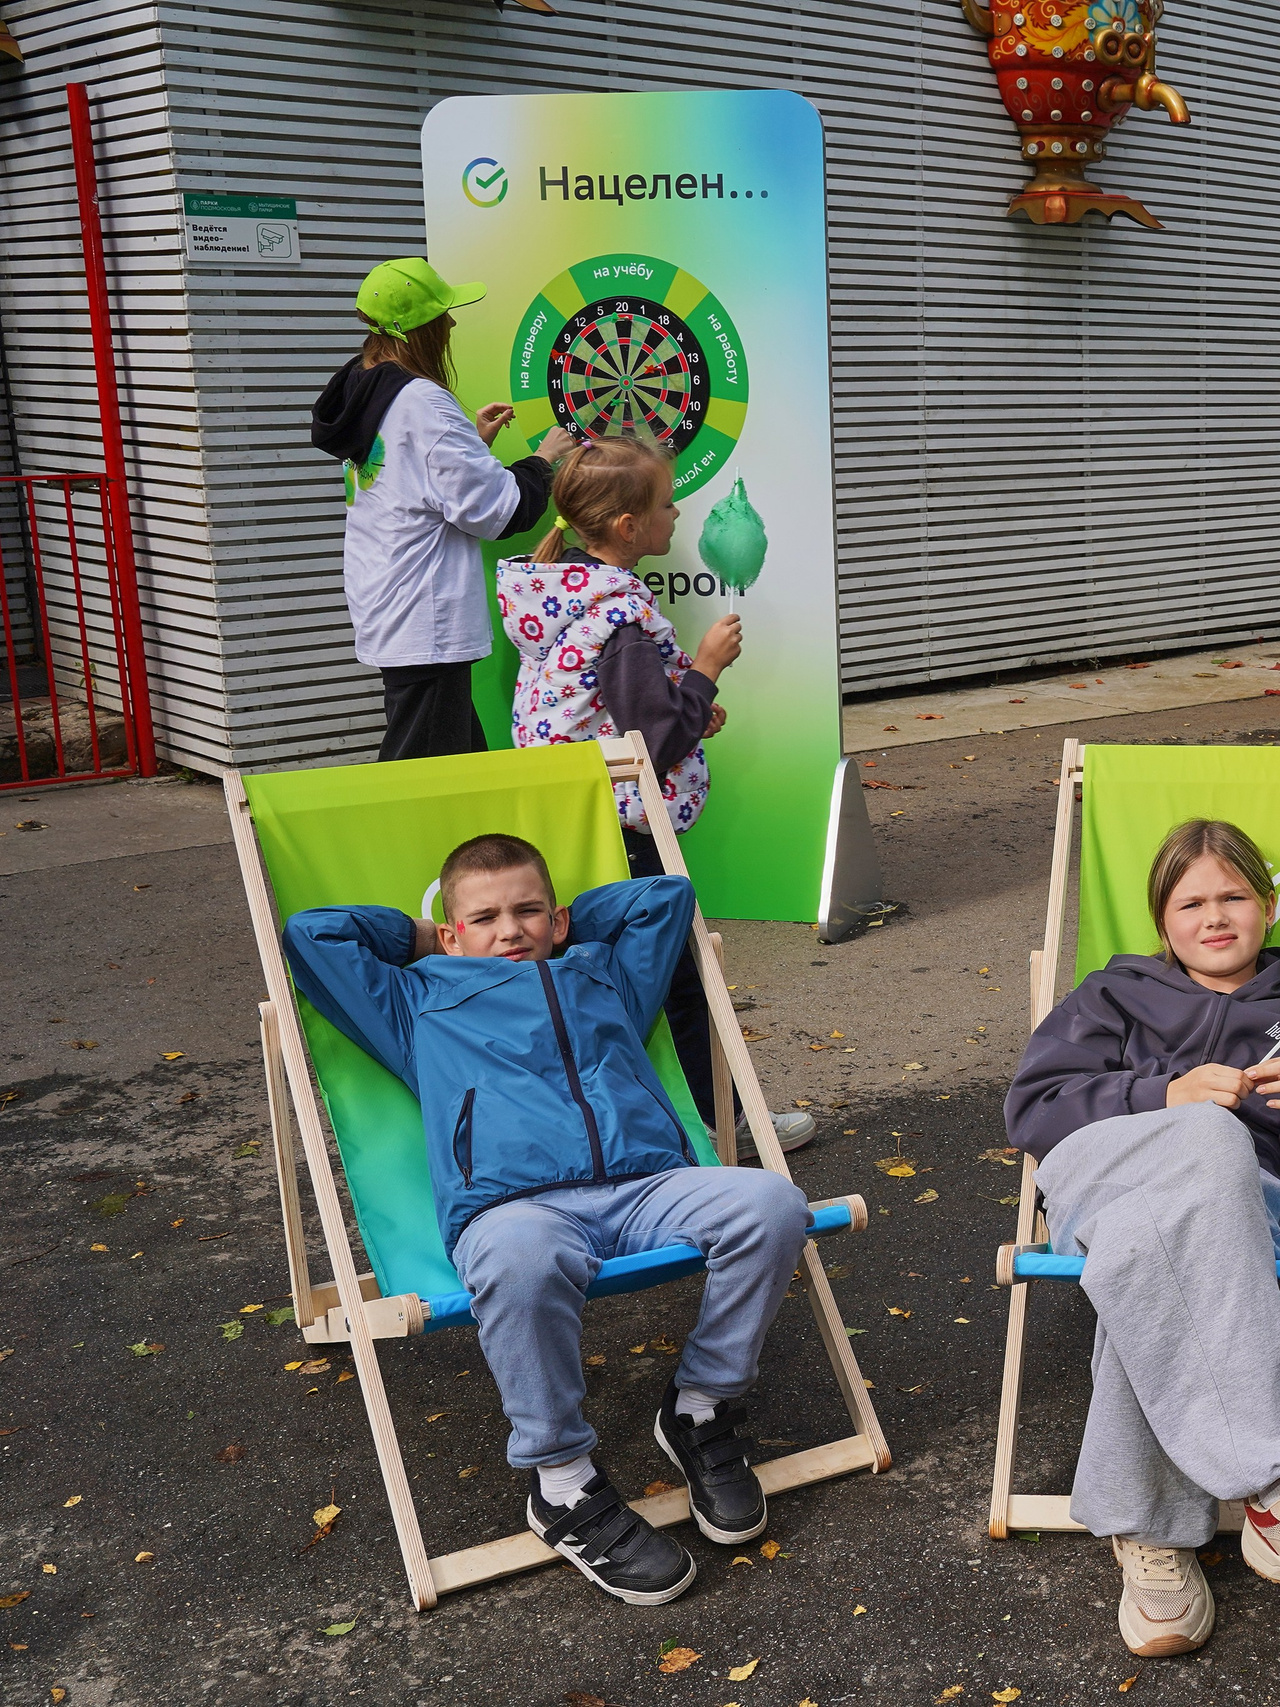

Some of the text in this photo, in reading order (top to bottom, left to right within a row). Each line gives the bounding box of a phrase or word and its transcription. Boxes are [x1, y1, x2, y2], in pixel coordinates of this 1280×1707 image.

[538, 166, 769, 206] Нацелен...
[192, 224, 228, 233] Ведётся
[194, 244, 250, 253] наблюдение!
[593, 263, 654, 280] на учёбу
[597, 306, 604, 315] 5
[615, 302, 629, 312] 20
[640, 305, 646, 314] 1
[574, 317, 587, 327] 12
[658, 315, 670, 325] 18
[564, 333, 571, 343] 9
[677, 333, 684, 343] 4
[520, 310, 548, 388] на карьеру
[707, 313, 738, 384] на работу
[687, 353, 699, 363] 13
[552, 379, 561, 389] 11
[693, 375, 700, 385] 6
[558, 403, 565, 413] 8
[690, 401, 701, 411] 10
[566, 422, 577, 432] 16
[682, 420, 693, 430] 15
[667, 438, 674, 448] 2
[700, 450, 716, 467] на
